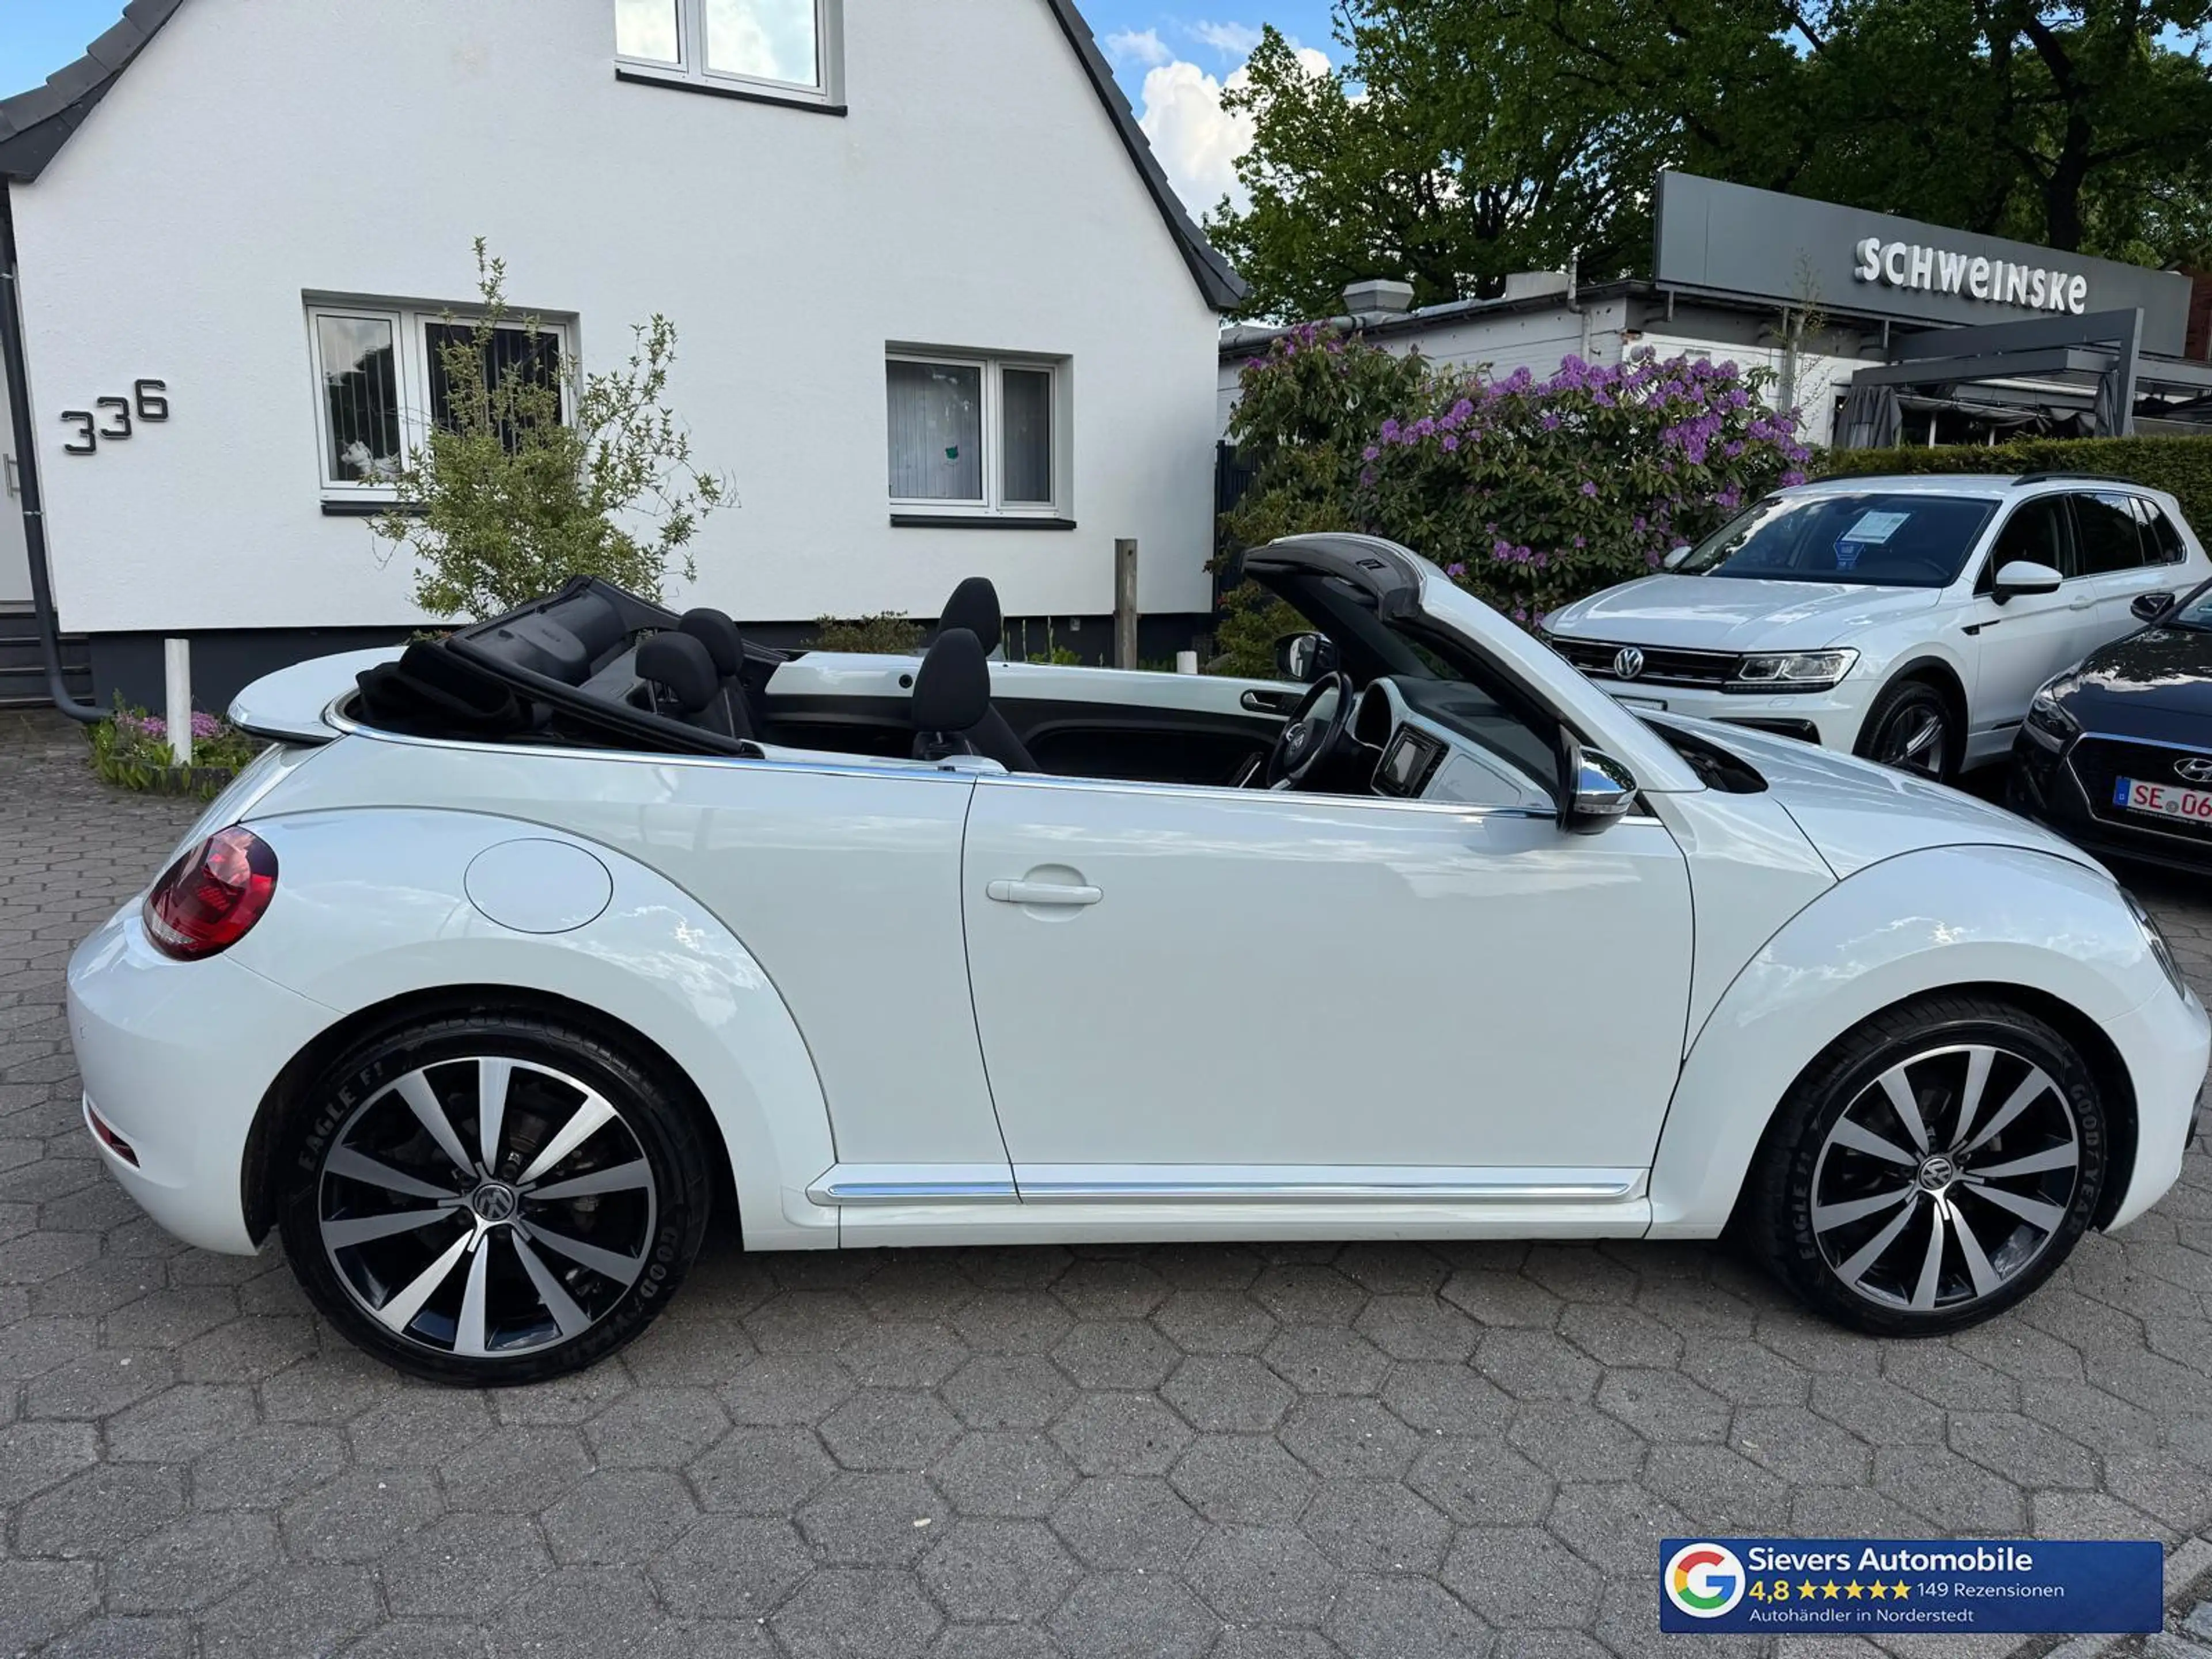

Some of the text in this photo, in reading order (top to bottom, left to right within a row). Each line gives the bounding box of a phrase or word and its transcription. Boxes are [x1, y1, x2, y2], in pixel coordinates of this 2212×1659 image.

[60, 378, 169, 455] 336
[2134, 785, 2165, 809] SE
[298, 1085, 358, 1172] EAGLE
[1791, 1183, 1816, 1260] EAGLE
